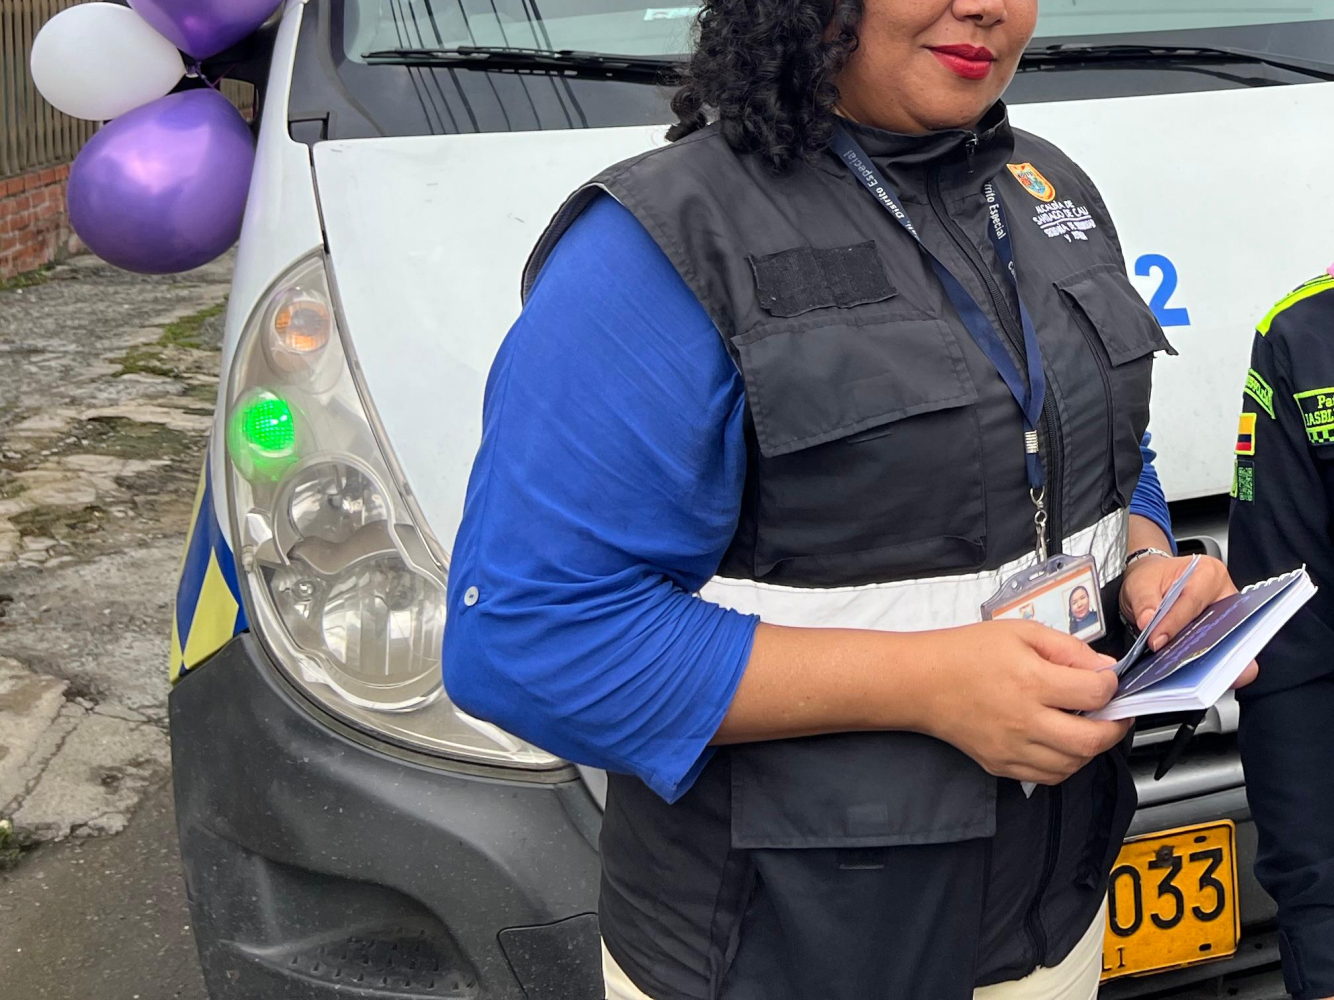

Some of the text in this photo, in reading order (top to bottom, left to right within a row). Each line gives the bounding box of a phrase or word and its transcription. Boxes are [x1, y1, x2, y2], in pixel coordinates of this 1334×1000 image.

[842, 149, 878, 188] Especial
[875, 186, 905, 220] Distrito
[988, 203, 1007, 240] Especial
[1134, 253, 1191, 327] 2
[1107, 847, 1226, 938] 033
[1101, 946, 1127, 974] LI
